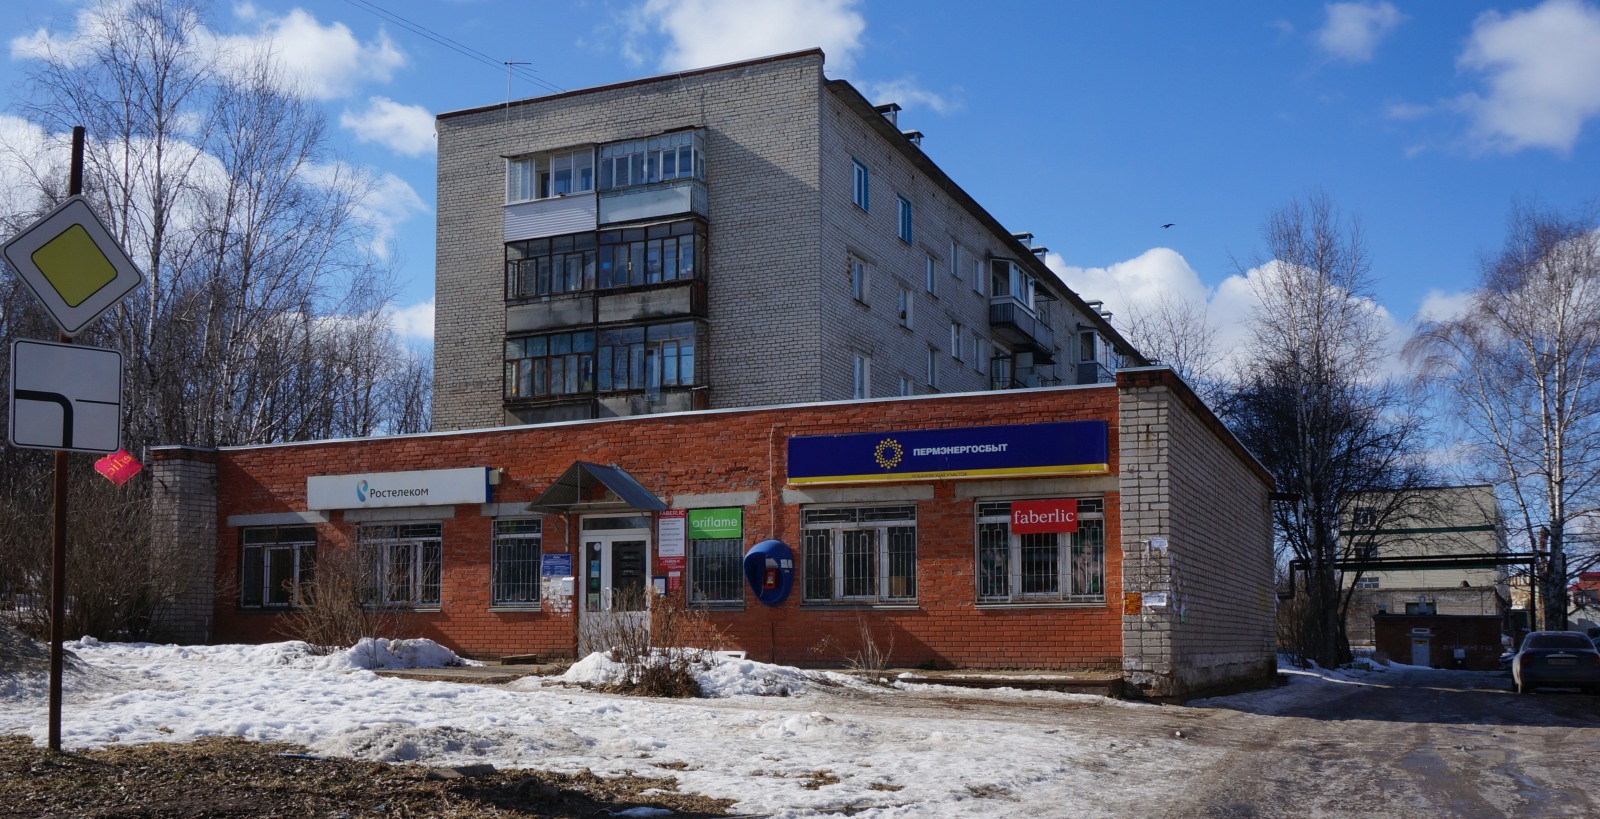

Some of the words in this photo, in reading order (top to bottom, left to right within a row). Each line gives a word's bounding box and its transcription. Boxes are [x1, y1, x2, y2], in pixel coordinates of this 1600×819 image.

[913, 443, 1008, 456] ПЕРМЭНЕРГОСБЫТ
[370, 488, 429, 498] Ростелеком
[693, 516, 737, 528] oriflame
[1013, 508, 1075, 525] faberlic
